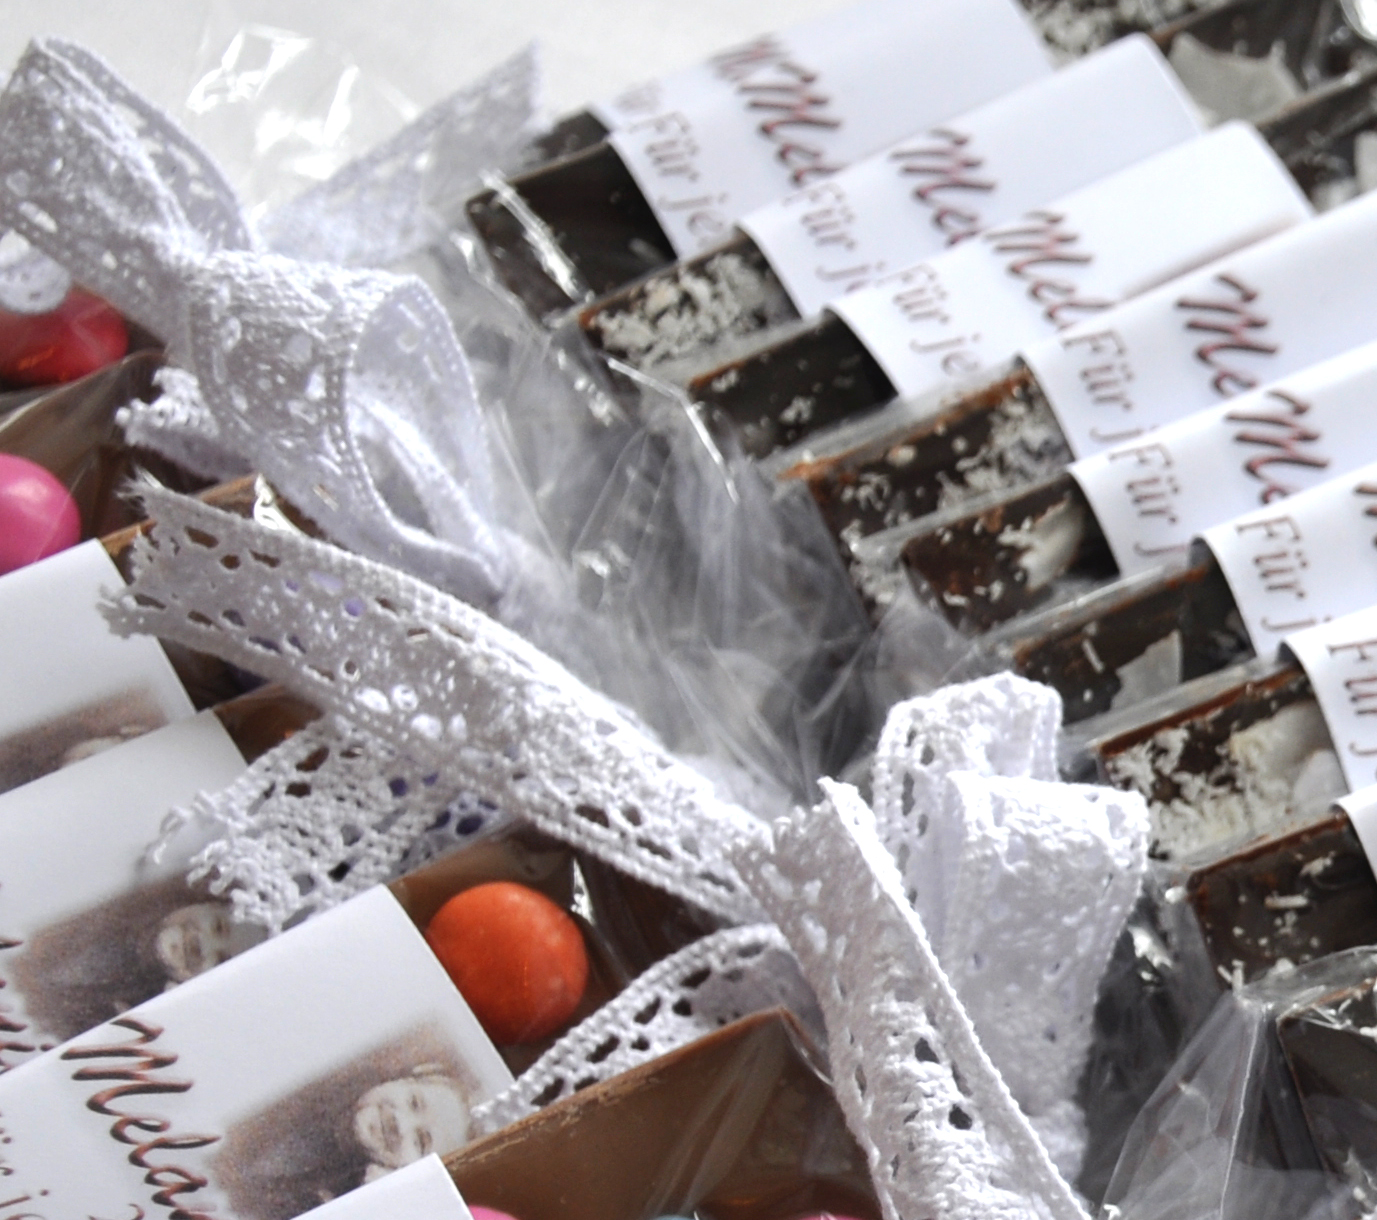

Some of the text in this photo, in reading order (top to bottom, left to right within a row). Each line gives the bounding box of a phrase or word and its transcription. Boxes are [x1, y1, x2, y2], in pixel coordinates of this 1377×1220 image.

[1061, 330, 1134, 412] Für
[1109, 443, 1180, 524] Für
[1236, 516, 1309, 600] Für
